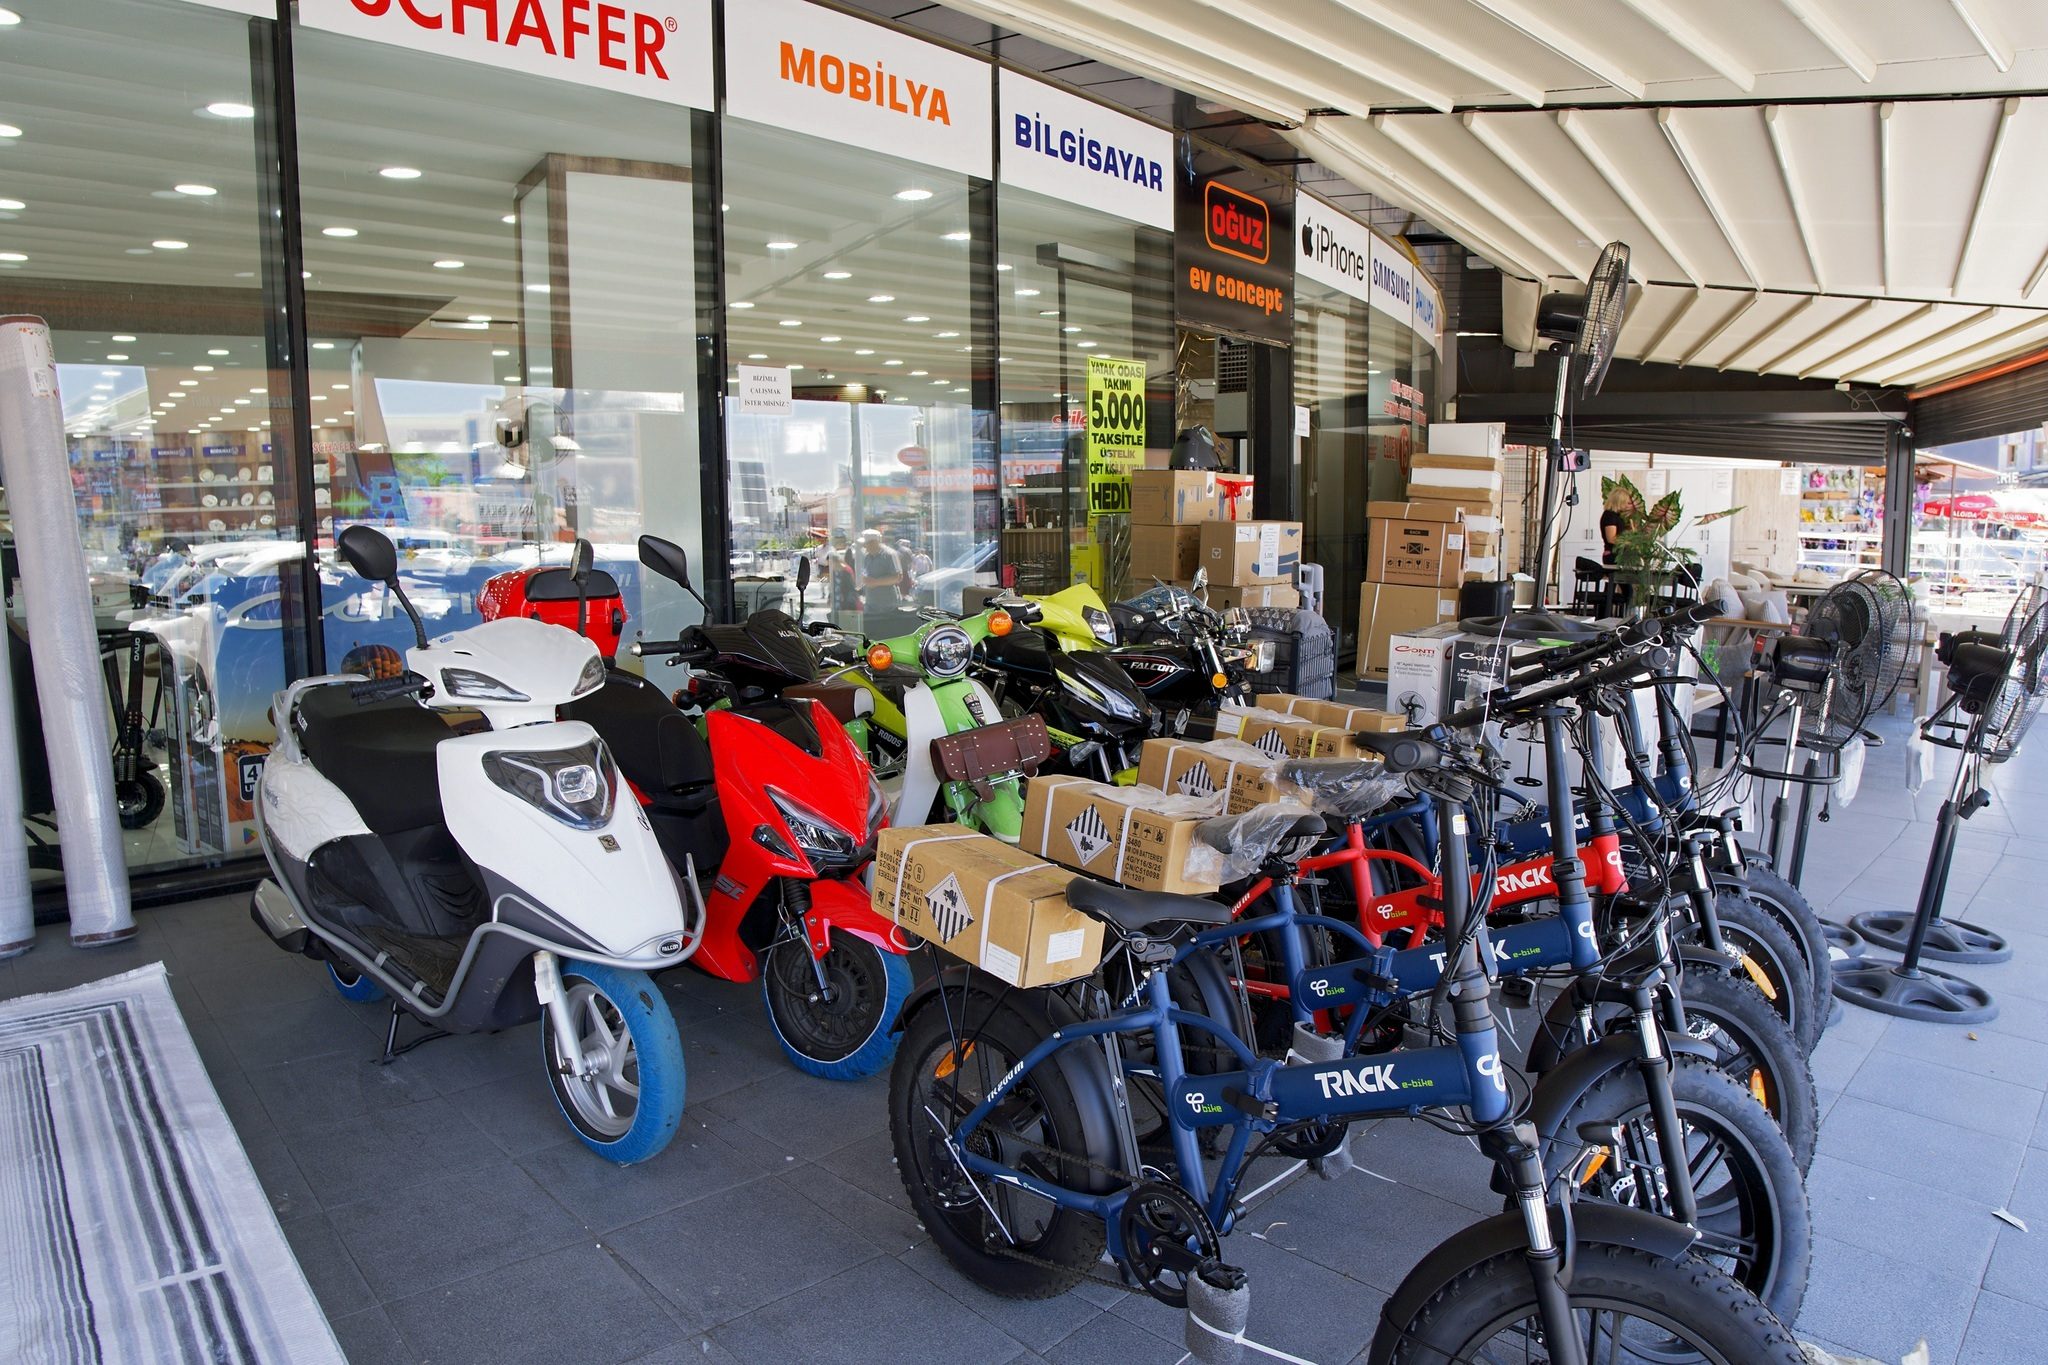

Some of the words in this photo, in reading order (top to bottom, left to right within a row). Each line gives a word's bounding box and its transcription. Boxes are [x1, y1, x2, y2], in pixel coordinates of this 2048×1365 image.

[780, 40, 951, 127] MOBİLYA
[1014, 111, 1163, 192] BİLGİSAYAR
[1212, 203, 1264, 250] OĞUZ
[1316, 223, 1364, 282] iPhone
[1189, 266, 1211, 292] ev
[1215, 274, 1283, 316] concept
[1373, 258, 1411, 305] SAMSUNG
[1415, 287, 1434, 329] PHILIPS
[1091, 360, 1115, 375] YATAK
[1117, 364, 1144, 379] ODASI
[1103, 377, 1132, 391] TAKIMI
[1091, 390, 1144, 431] 5.000
[1091, 432, 1143, 446] TAKSİTLE
[1129, 661, 1177, 673] FALCON
[878, 728, 903, 748] RODOS
[1139, 849, 1164, 863] BATTERIES
[1493, 865, 1551, 896] RACK
[912, 894, 923, 907] UN
[1512, 946, 1541, 959] e-bike
[1325, 986, 1345, 996] bike
[986, 1060, 1024, 1103] TK200m
[1314, 1063, 1400, 1100] TRACK
[1401, 1078, 1434, 1090] e-bike
[1201, 1104, 1223, 1113] bike
